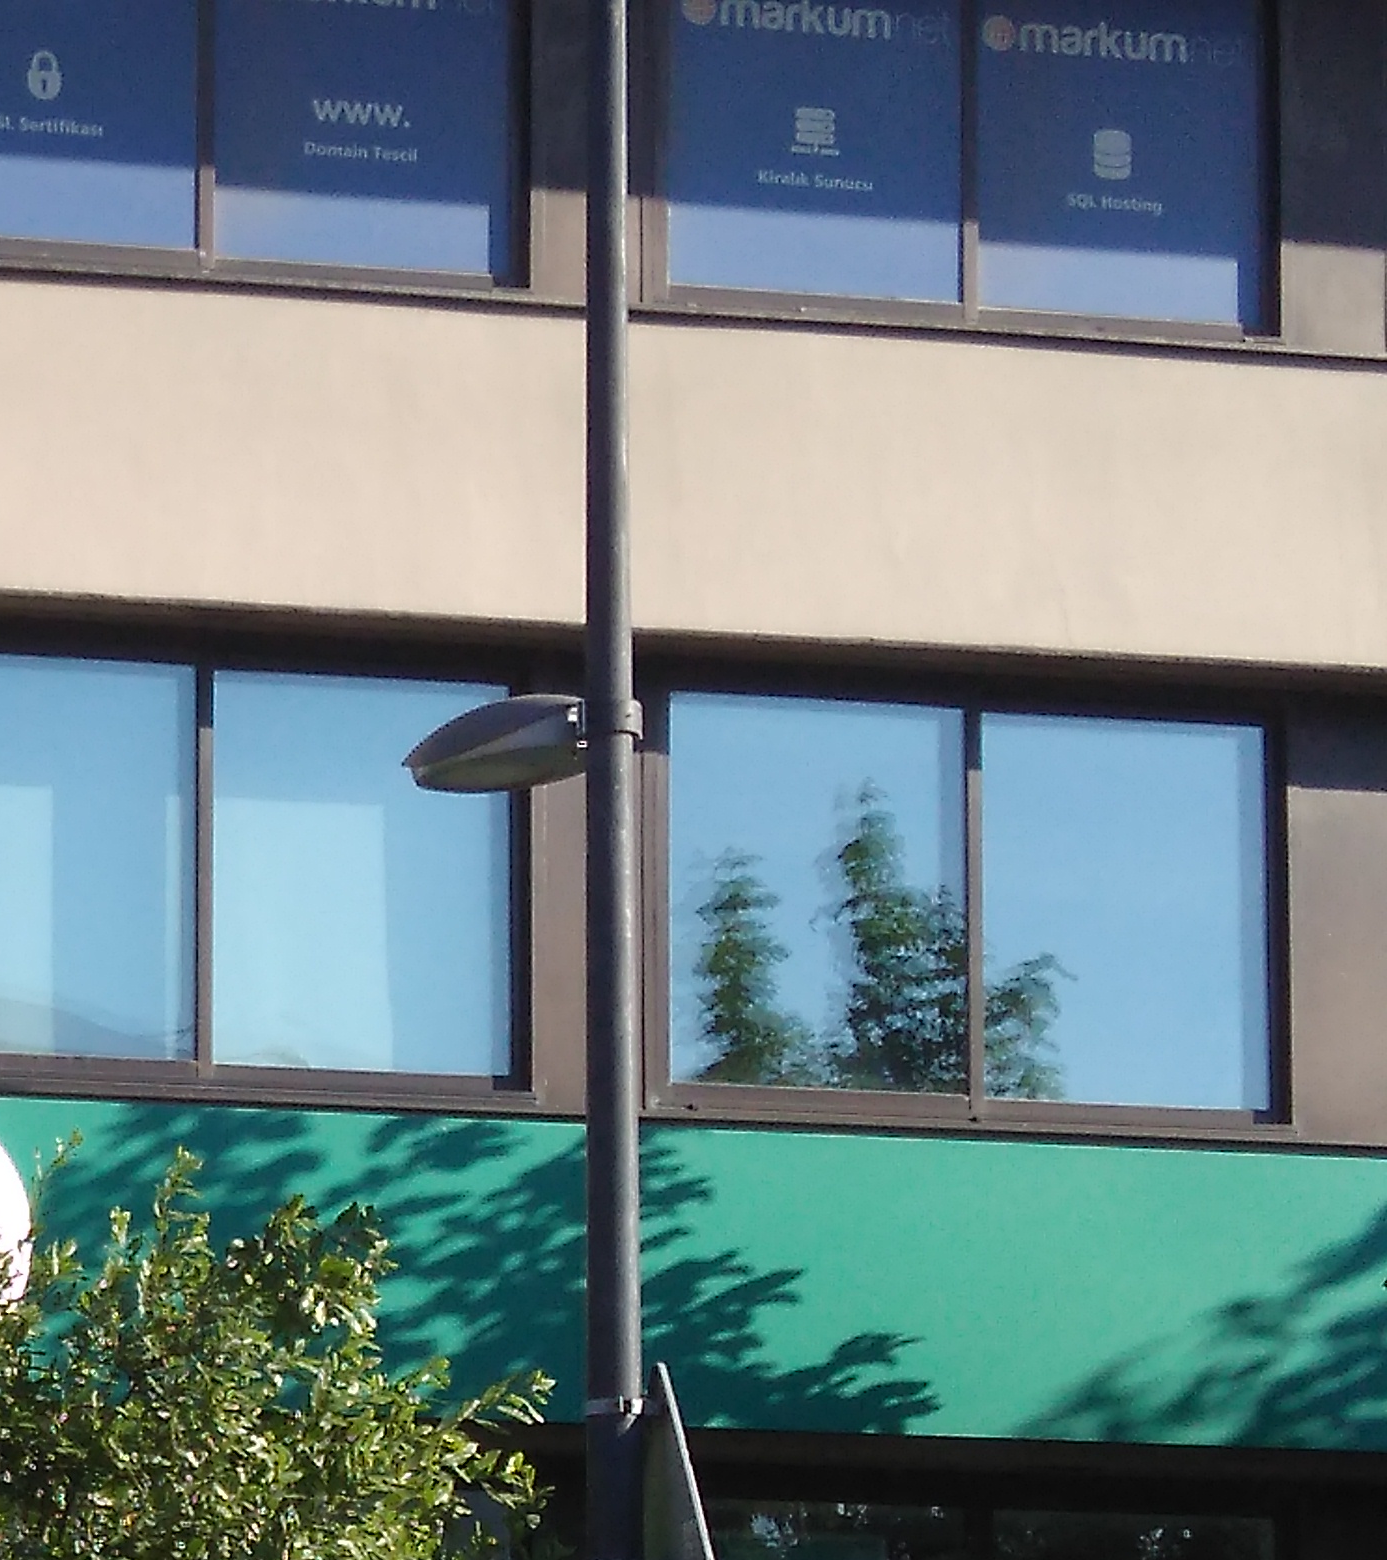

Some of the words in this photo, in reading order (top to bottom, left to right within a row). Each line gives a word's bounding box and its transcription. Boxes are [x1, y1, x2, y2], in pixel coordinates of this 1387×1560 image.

[311, 98, 412, 129] www.
[303, 140, 368, 160] Domain
[373, 144, 419, 163] Tescil
[1102, 195, 1163, 216] Hosting
